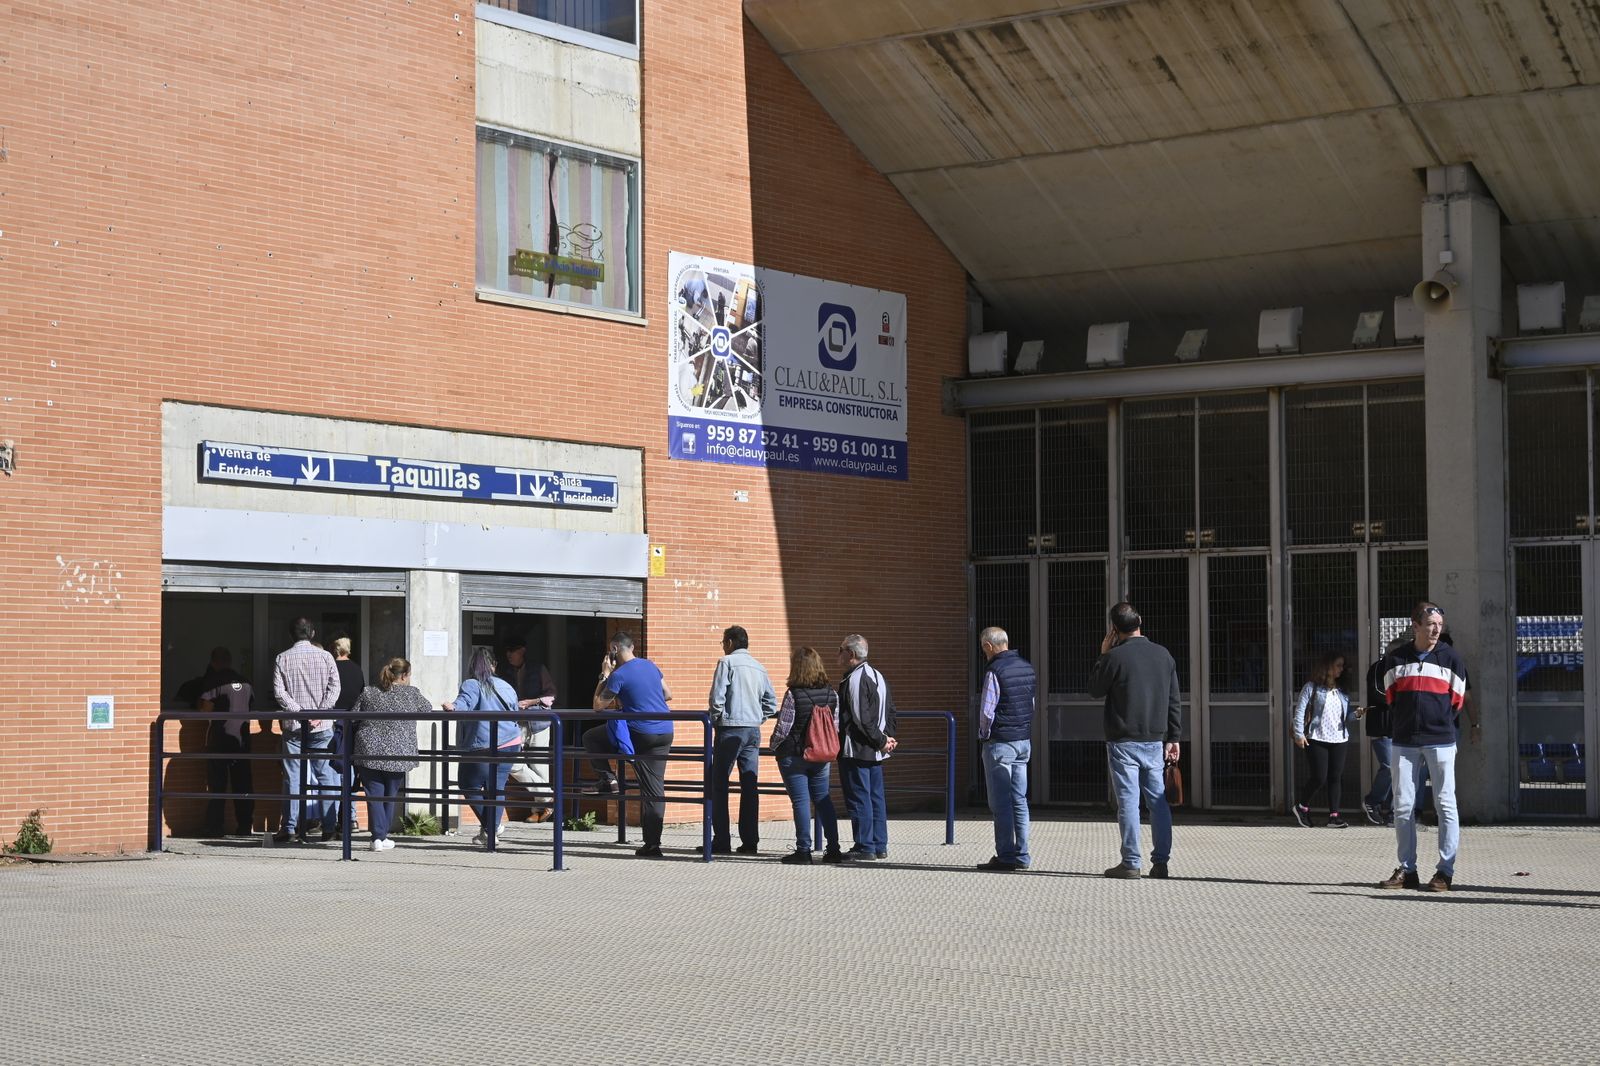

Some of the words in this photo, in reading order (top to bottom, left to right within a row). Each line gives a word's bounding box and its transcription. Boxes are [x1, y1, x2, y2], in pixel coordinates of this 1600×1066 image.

[774, 365, 874, 402] CLAU&PAUL,
[877, 380, 902, 403] S.L.
[779, 394, 824, 412] EMPRESA
[825, 401, 899, 421] CONSTRUCTORA
[707, 424, 735, 442] 959
[738, 428, 757, 444] 87
[761, 430, 779, 446] 52
[782, 433, 800, 449] 41
[812, 436, 838, 453] 959
[841, 440, 858, 455] 61
[861, 442, 878, 457] 00
[881, 444, 897, 459] 11
[218, 447, 253, 459] Venta
[256, 451, 271, 462] de
[706, 442, 800, 463] info@clauypaul.es
[218, 462, 272, 477] Entradas
[813, 456, 898, 473] www.clauypaul.es
[375, 459, 481, 490] Taquillas
[552, 475, 583, 487] Salida
[552, 491, 560, 502] T.
[563, 492, 617, 505] Incidencias
